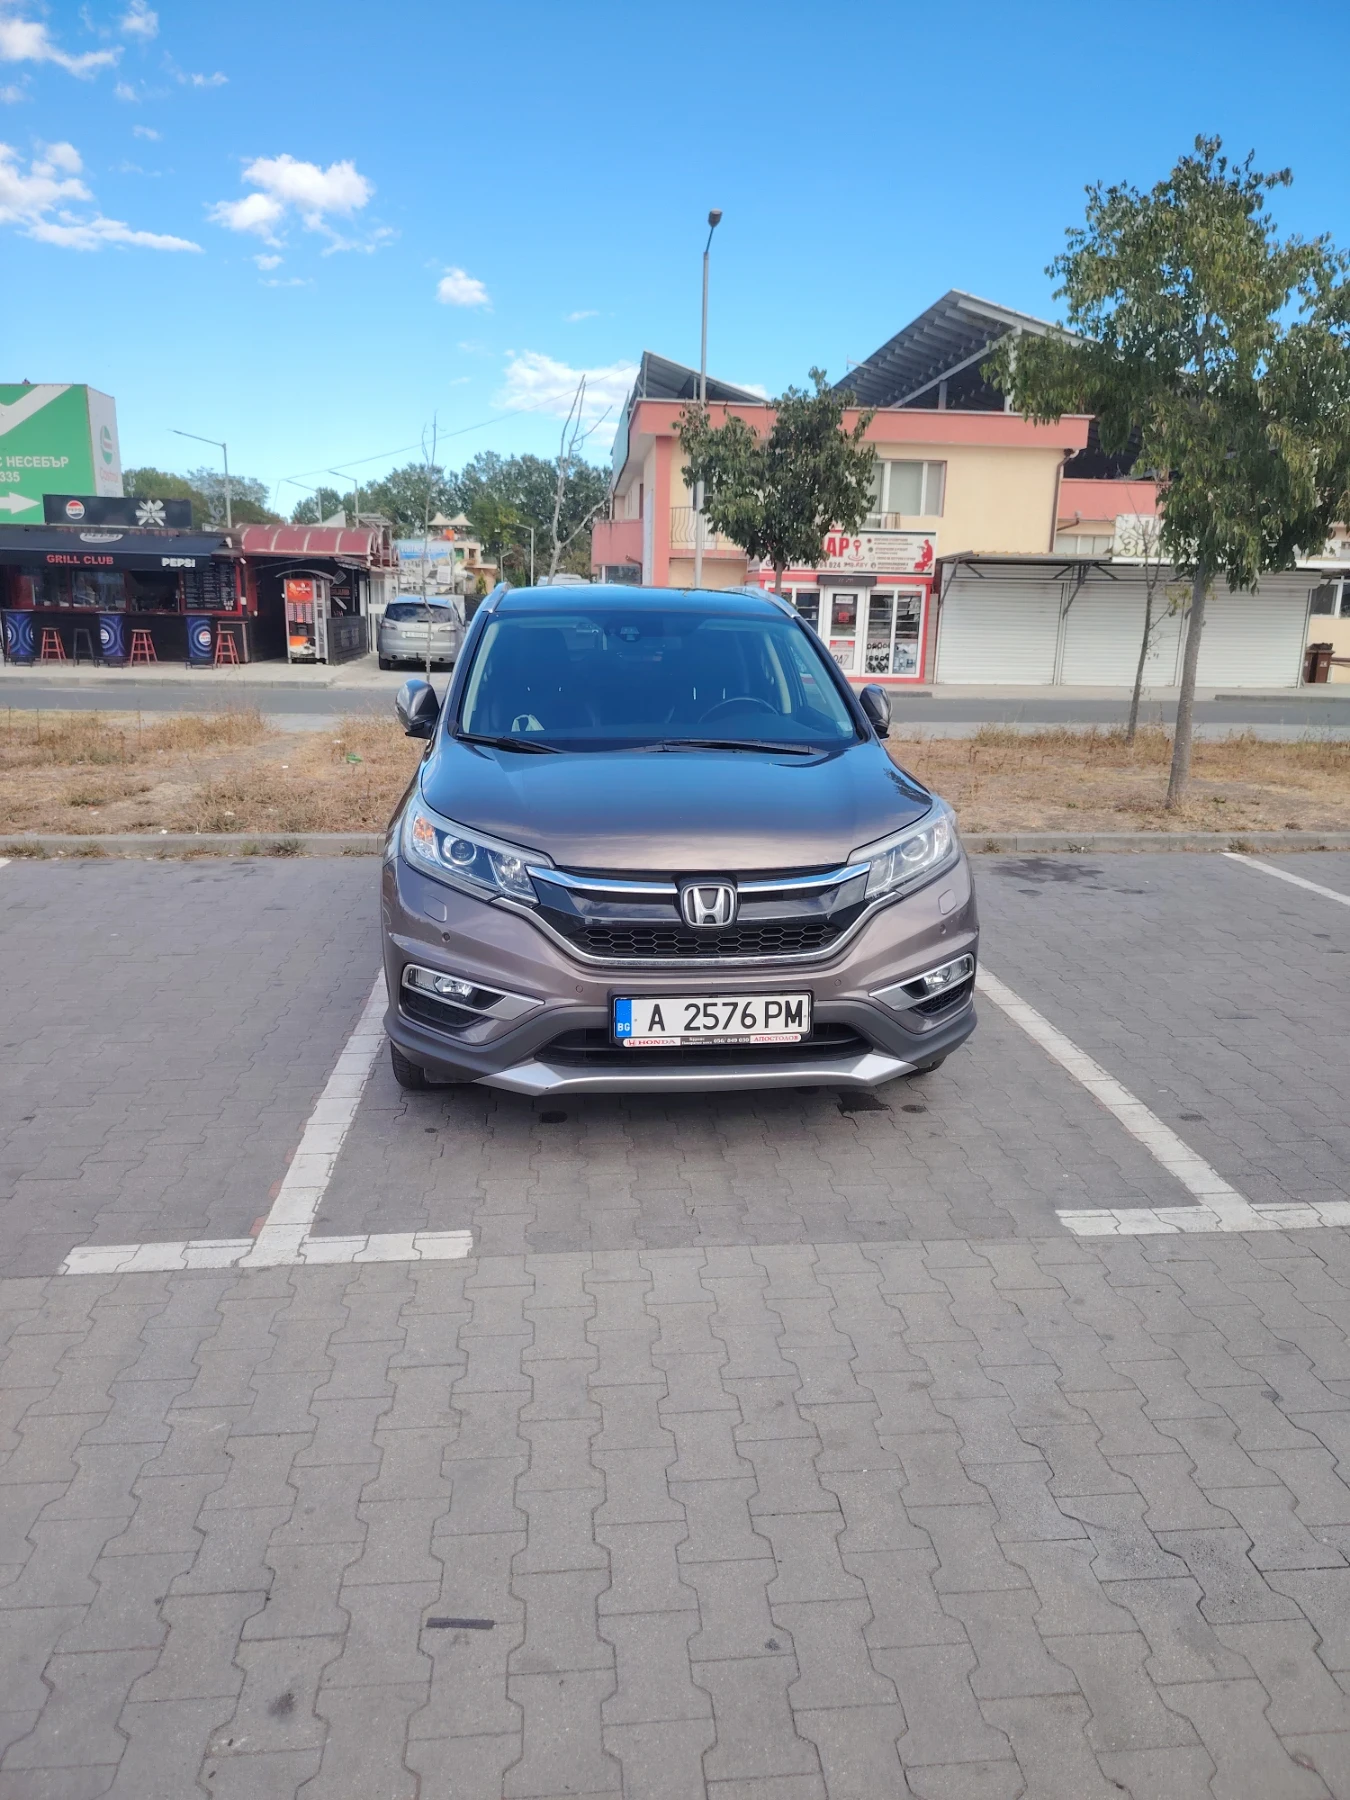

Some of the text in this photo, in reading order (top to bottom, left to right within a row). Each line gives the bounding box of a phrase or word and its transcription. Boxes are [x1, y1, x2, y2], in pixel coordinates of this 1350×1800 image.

[6, 456, 69, 467] НЕСЕБЪР
[46, 555, 114, 565] GRILL CLUB
[161, 557, 195, 568] PEPSI
[648, 1000, 803, 1032] A 2576 PM
[617, 1023, 631, 1031] BG
